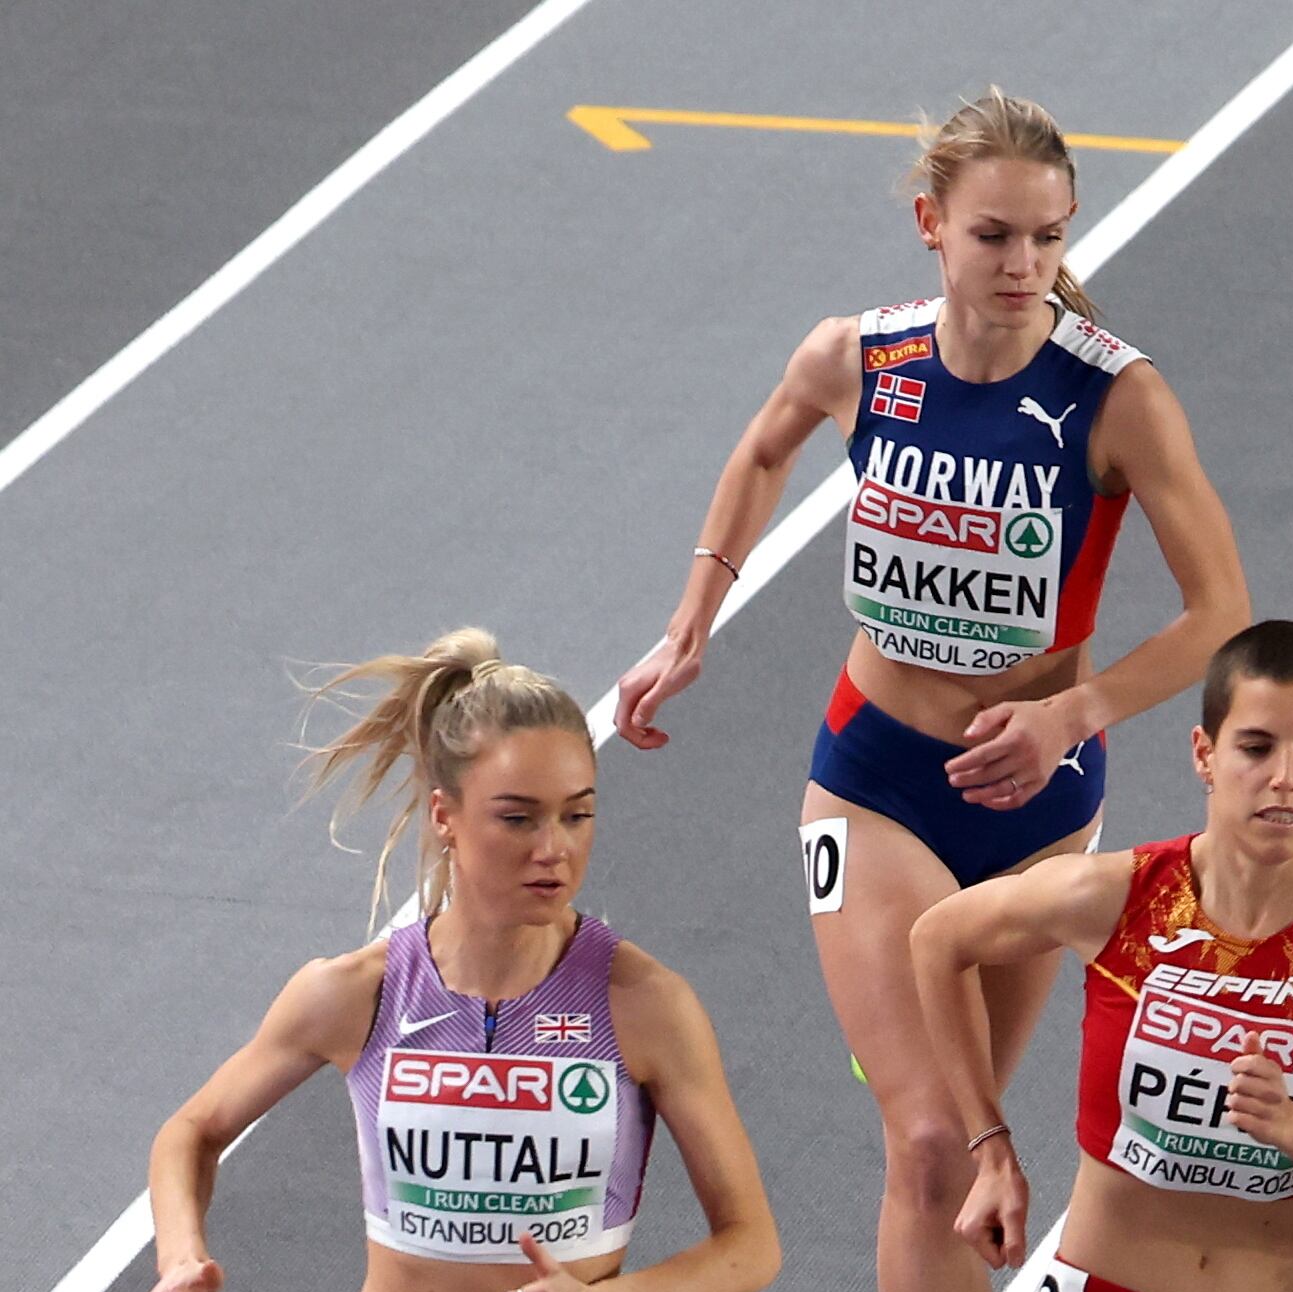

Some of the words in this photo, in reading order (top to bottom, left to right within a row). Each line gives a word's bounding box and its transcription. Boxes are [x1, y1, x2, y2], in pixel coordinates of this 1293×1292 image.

[889, 343, 928, 361] EXTRA
[866, 436, 1061, 510] NORWAY
[855, 489, 998, 546] SPAR
[852, 543, 1047, 619] BAKKEN
[880, 605, 885, 620] I
[889, 607, 929, 629] RUN
[934, 618, 998, 639] CLEAN
[862, 623, 966, 668] STANBUL
[391, 1060, 549, 1104] SPAR
[386, 1127, 602, 1184] NUTTALL
[1122, 1139, 1243, 1190] ISTANBUL
[1156, 1130, 1163, 1143] I
[1165, 1134, 1210, 1156] RUN
[1214, 1142, 1279, 1168] CLEAN
[426, 1190, 431, 1205] I
[434, 1190, 481, 1210] RUN
[485, 1192, 555, 1212] CLEAN
[401, 1211, 520, 1244] ISTANBUL
[527, 1215, 589, 1244] 2023
